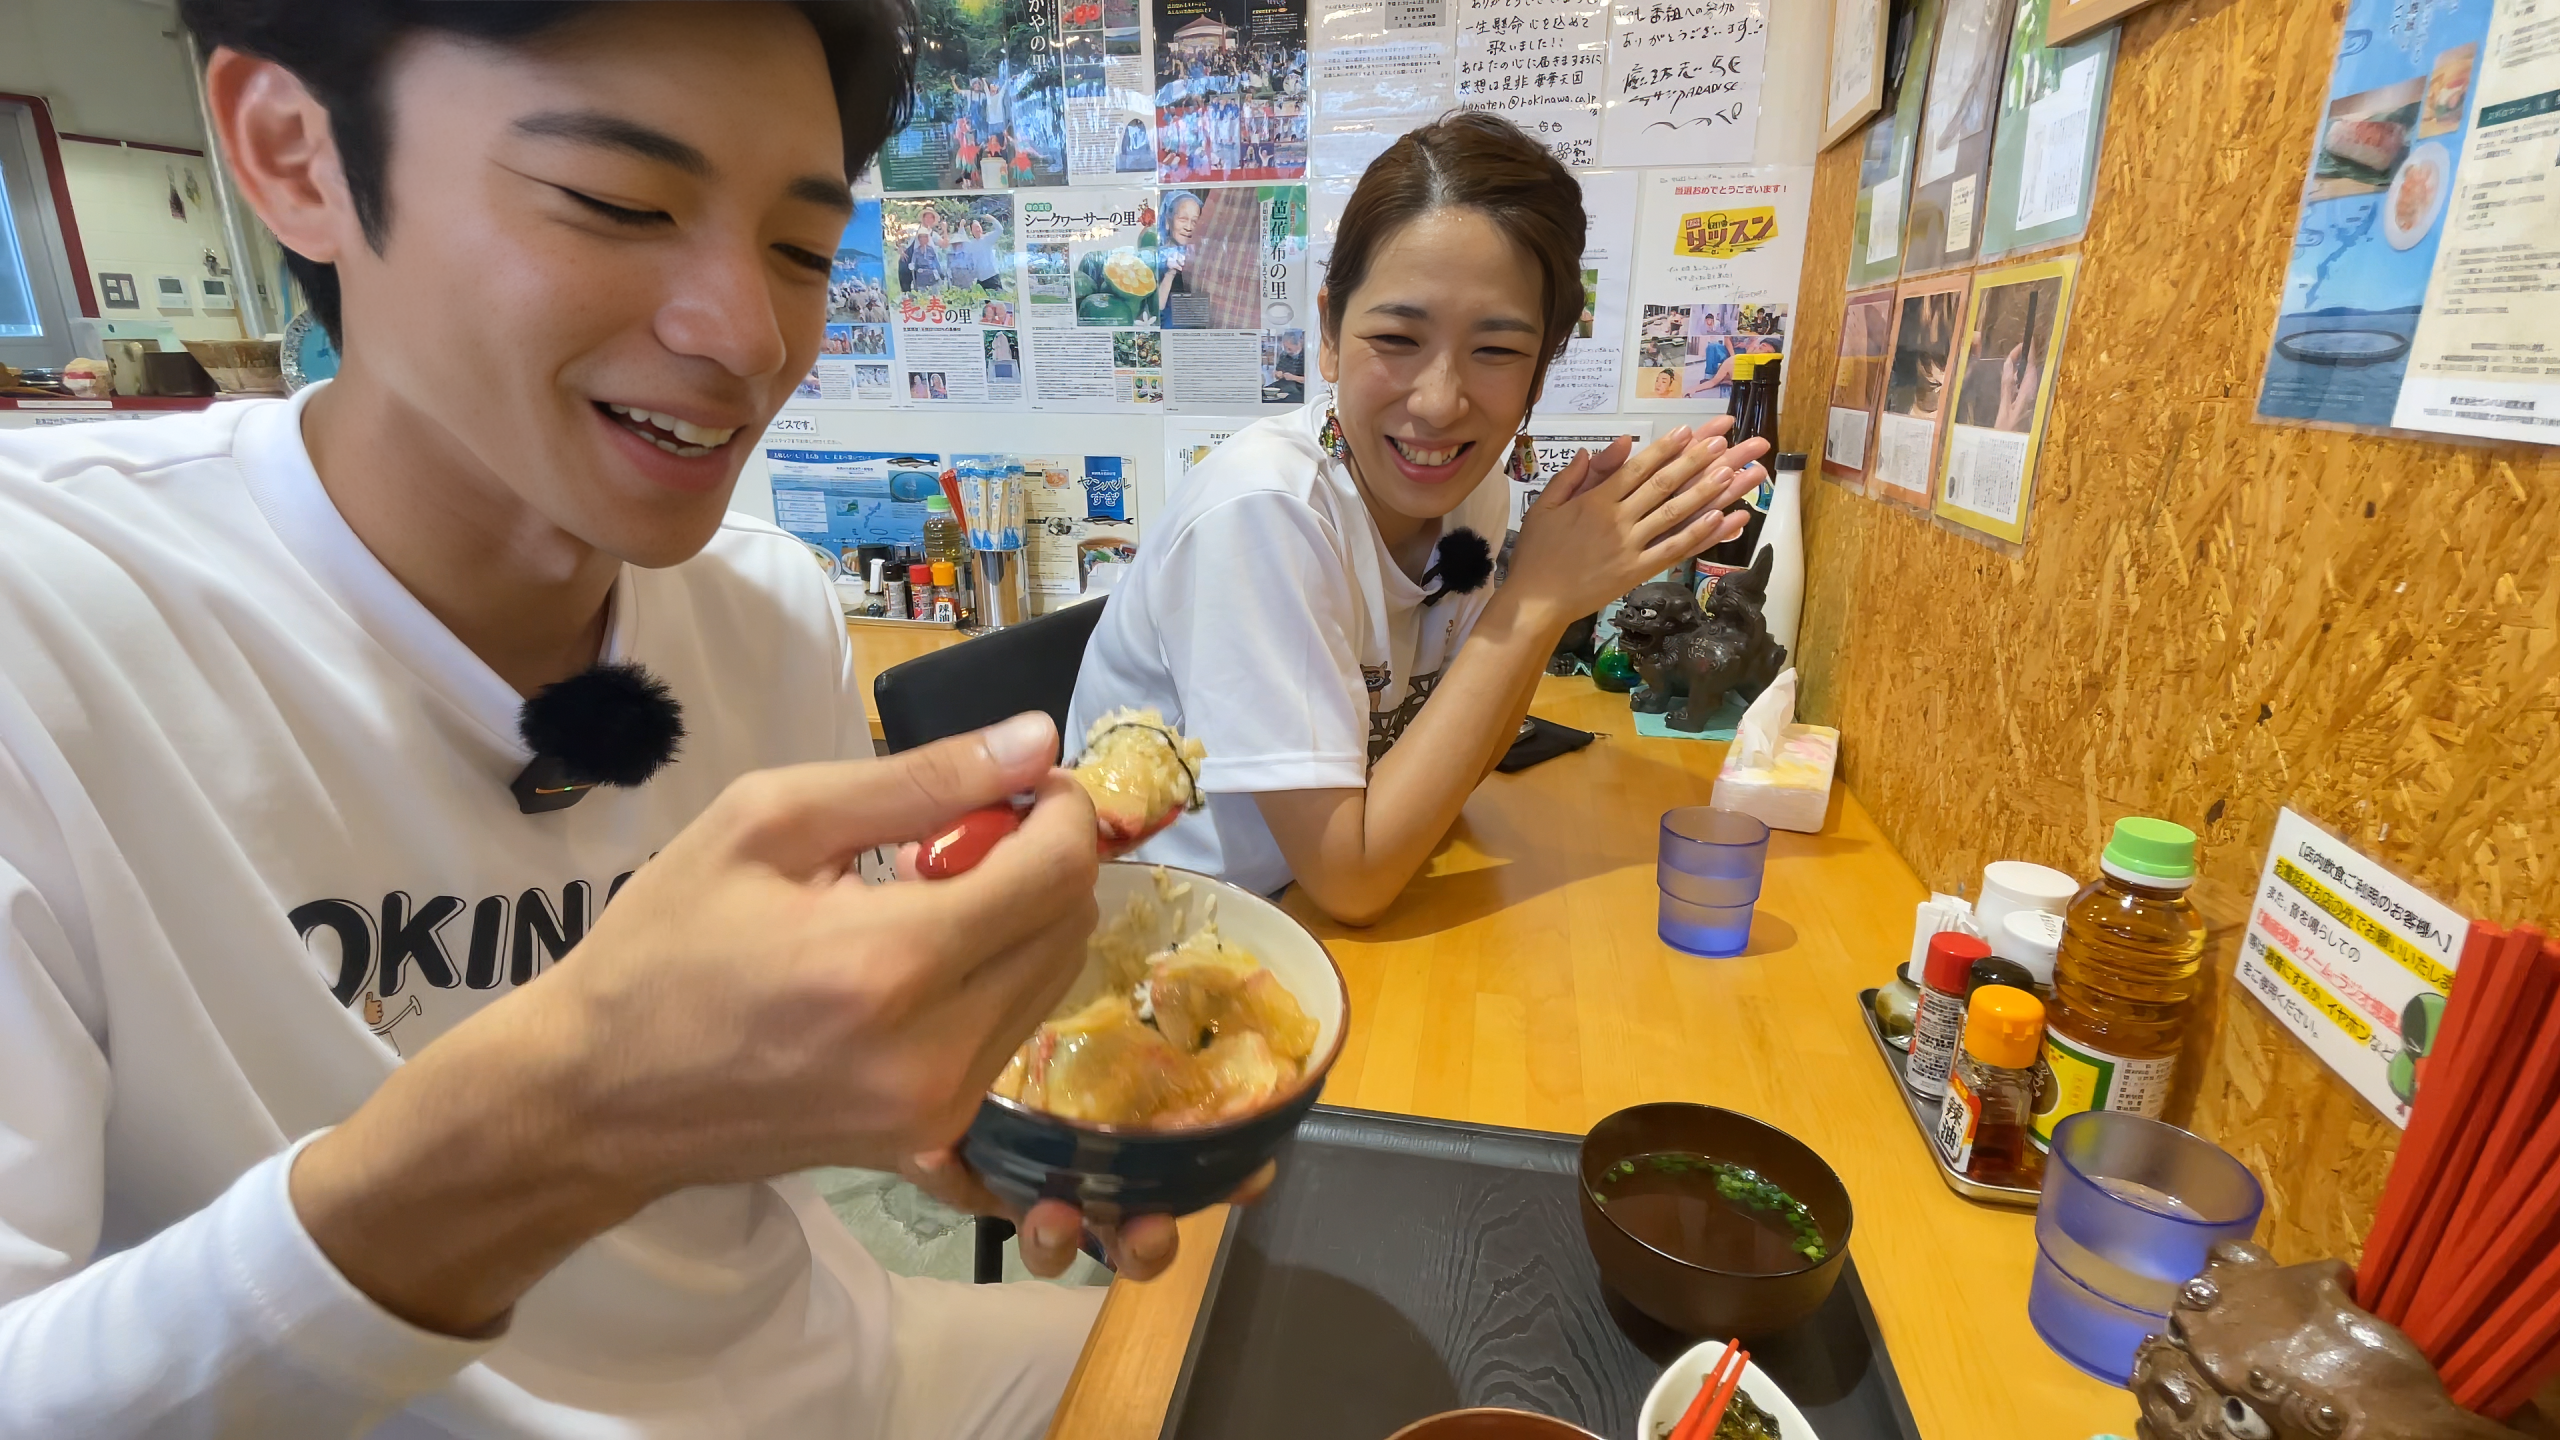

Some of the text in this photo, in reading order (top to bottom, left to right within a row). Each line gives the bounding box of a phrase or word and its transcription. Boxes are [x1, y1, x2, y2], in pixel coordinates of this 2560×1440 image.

[1025, 212, 1137, 227] シークヮーサーの里
[899, 295, 972, 324] 長寿の里
[1941, 1096, 1964, 1150] 辣油
